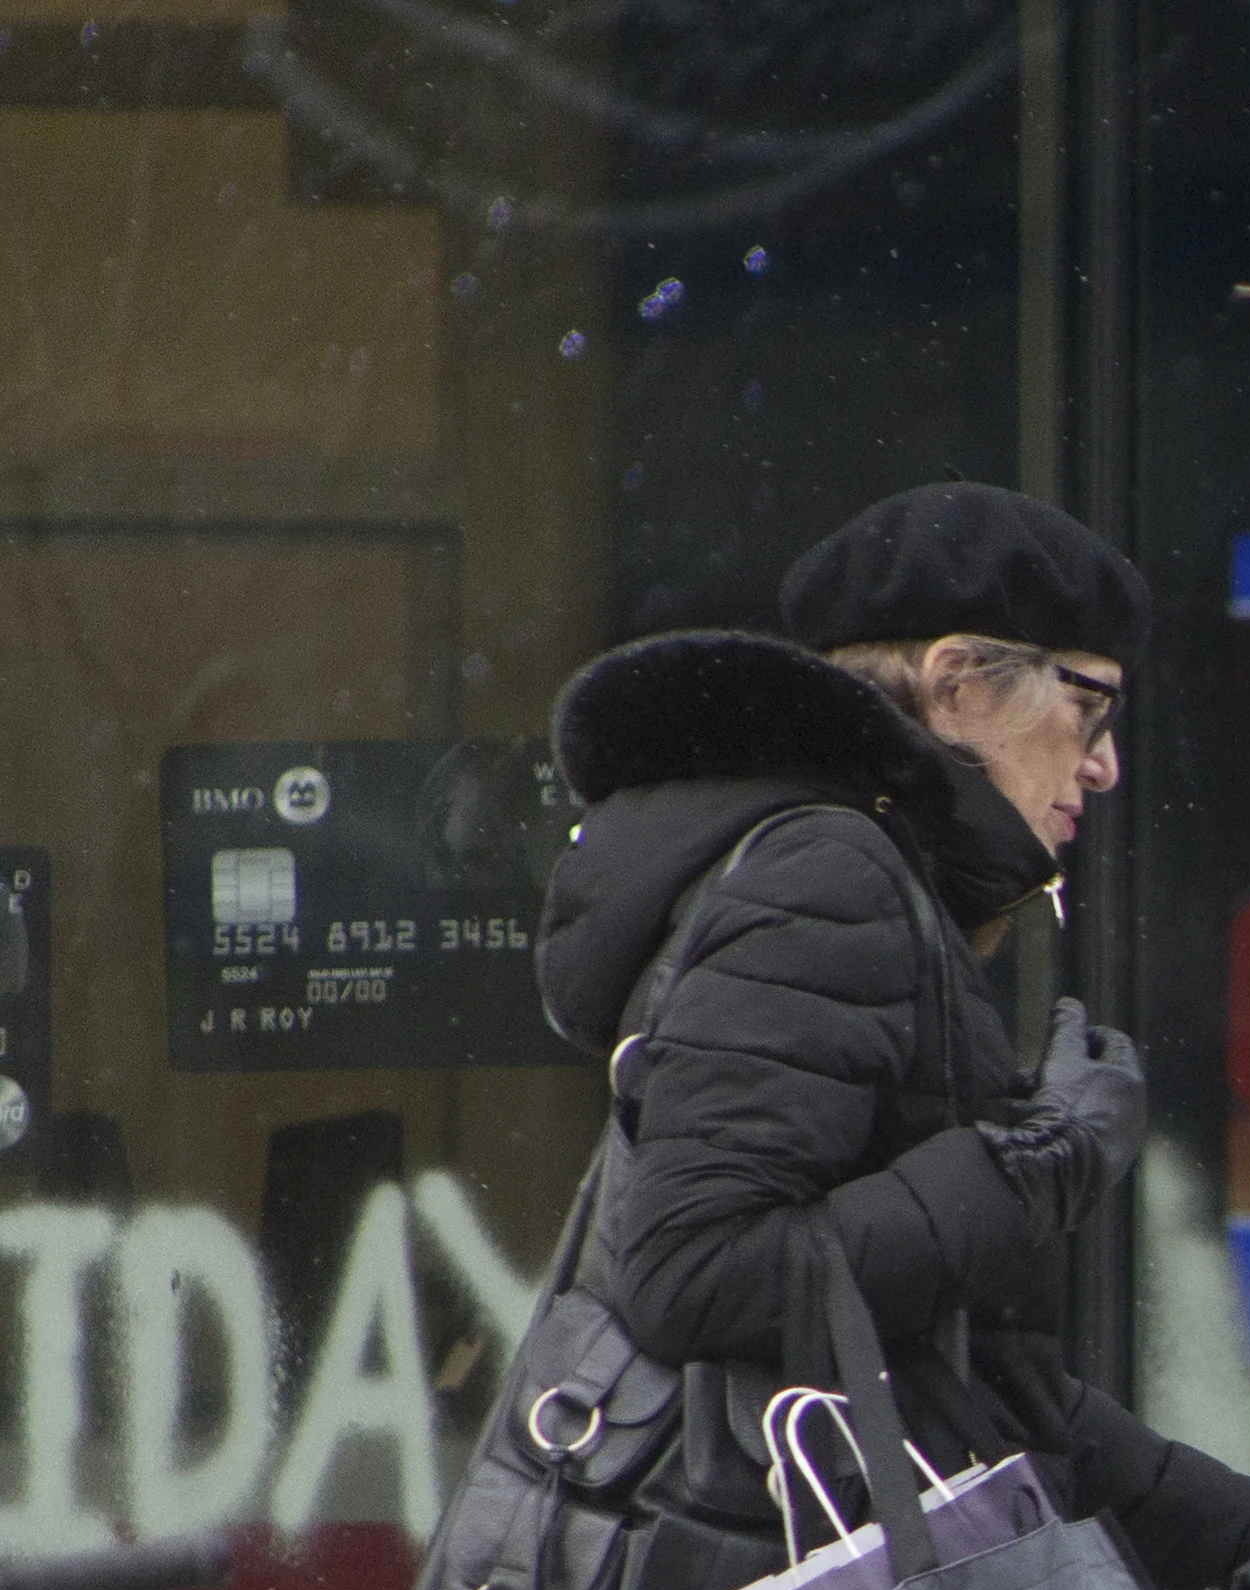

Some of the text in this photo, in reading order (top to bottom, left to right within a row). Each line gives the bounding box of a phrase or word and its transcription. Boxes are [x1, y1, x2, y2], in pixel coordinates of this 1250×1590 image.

[192, 787, 265, 813] BMO
[212, 917, 529, 956] 5524 8912 3456
[307, 980, 387, 1003] 00/00
[200, 1006, 313, 1034] J R ROY
